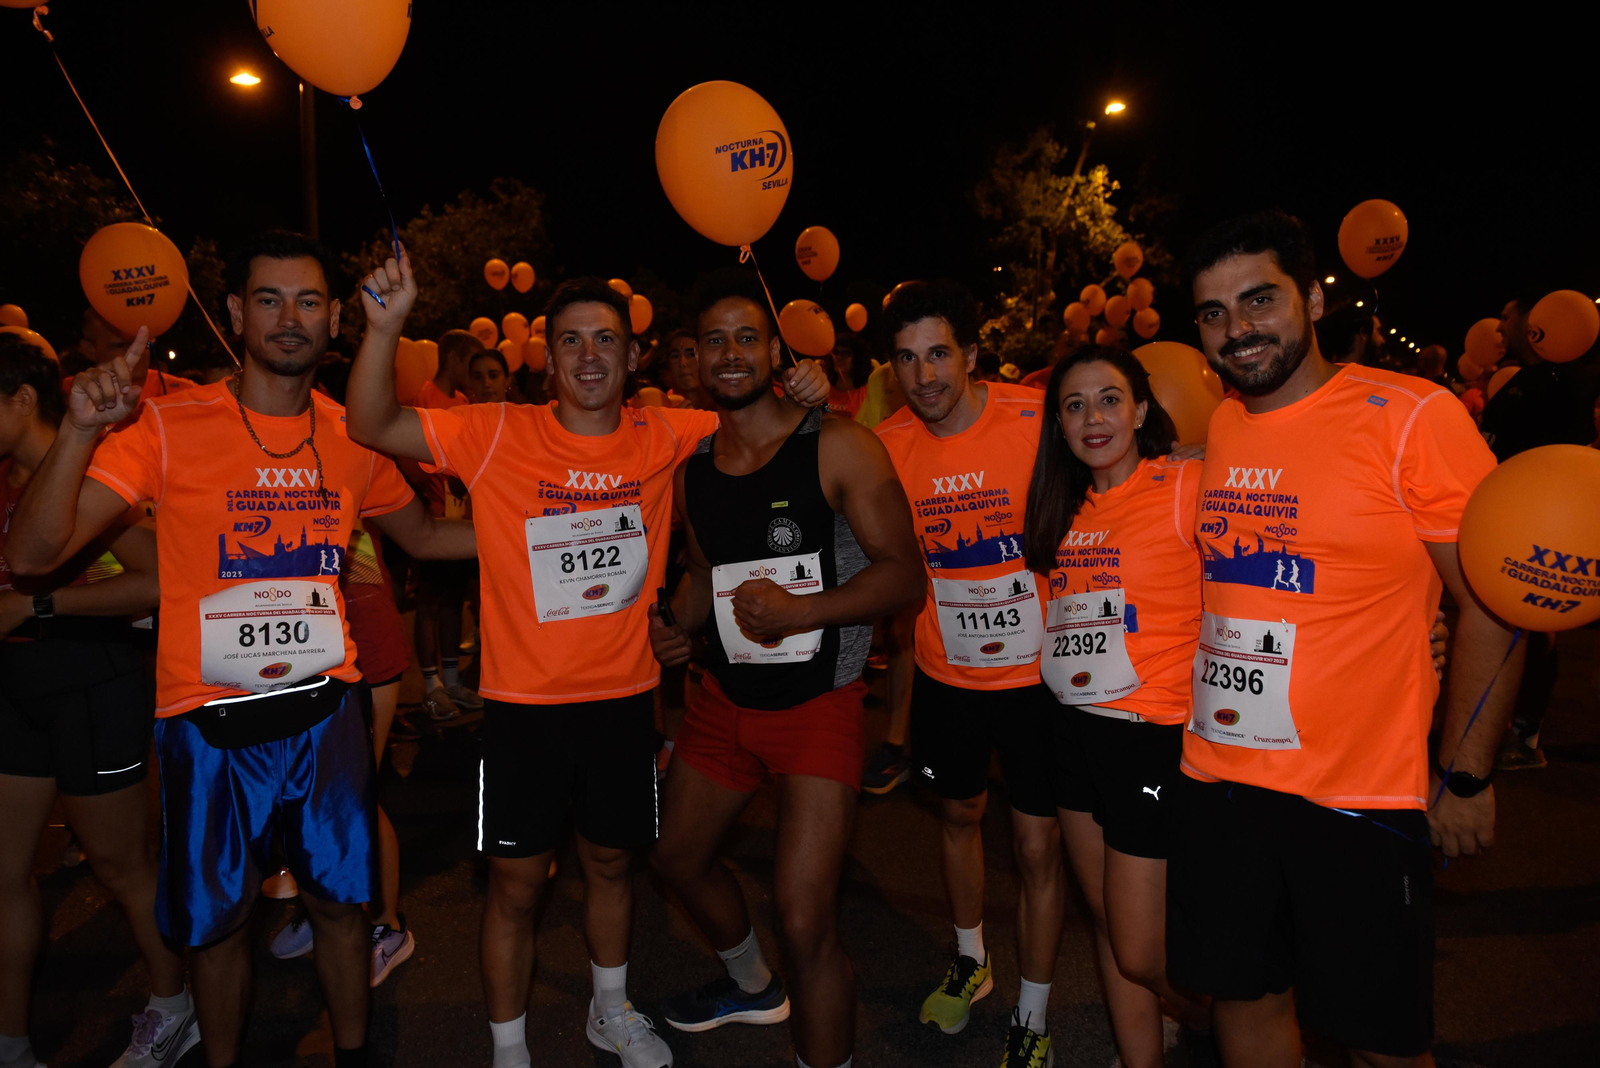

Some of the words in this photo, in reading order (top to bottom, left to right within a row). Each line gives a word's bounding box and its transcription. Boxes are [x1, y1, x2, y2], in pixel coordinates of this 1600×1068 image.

[716, 137, 763, 154] NOCTURNA
[762, 178, 788, 190] SEVILLA
[1375, 235, 1400, 245] XXXV
[112, 265, 155, 281] XXXV
[134, 275, 168, 285] NOCTURNA
[109, 280, 170, 295] GUADALQUIVIR
[256, 468, 318, 487] XXXV
[564, 469, 622, 490] XXXV
[932, 471, 984, 495] XXXV
[1224, 467, 1283, 490] XXXV
[546, 488, 640, 501] GUADALQUIVIR
[914, 496, 954, 507] CARRERA
[958, 488, 1009, 501] NOCTURNA
[1204, 490, 1242, 500] CARRERA
[1246, 492, 1299, 504] NOCTURNA
[236, 500, 341, 511] GUADALQUIVIR
[922, 497, 1010, 517] GUADALQUIVIR
[1206, 500, 1298, 519] GUADALQUIVIR
[773, 519, 800, 533] CAMINO
[774, 538, 800, 552] SANTIAGO
[1064, 530, 1110, 546] XXXV
[561, 546, 621, 573] 8122
[1078, 547, 1121, 556] NOCTURNA
[1504, 557, 1557, 580] CARRERA
[576, 574, 606, 582] CHAMORRO
[957, 608, 1021, 630] 11143
[239, 621, 309, 647] 8130
[1052, 632, 1107, 658] 22392
[1231, 652, 1263, 662] GUADALQUIVIR
[1201, 659, 1264, 695] 22396
[1105, 683, 1135, 695] Cruzcampo
[1254, 735, 1291, 744] Cruzcampo
